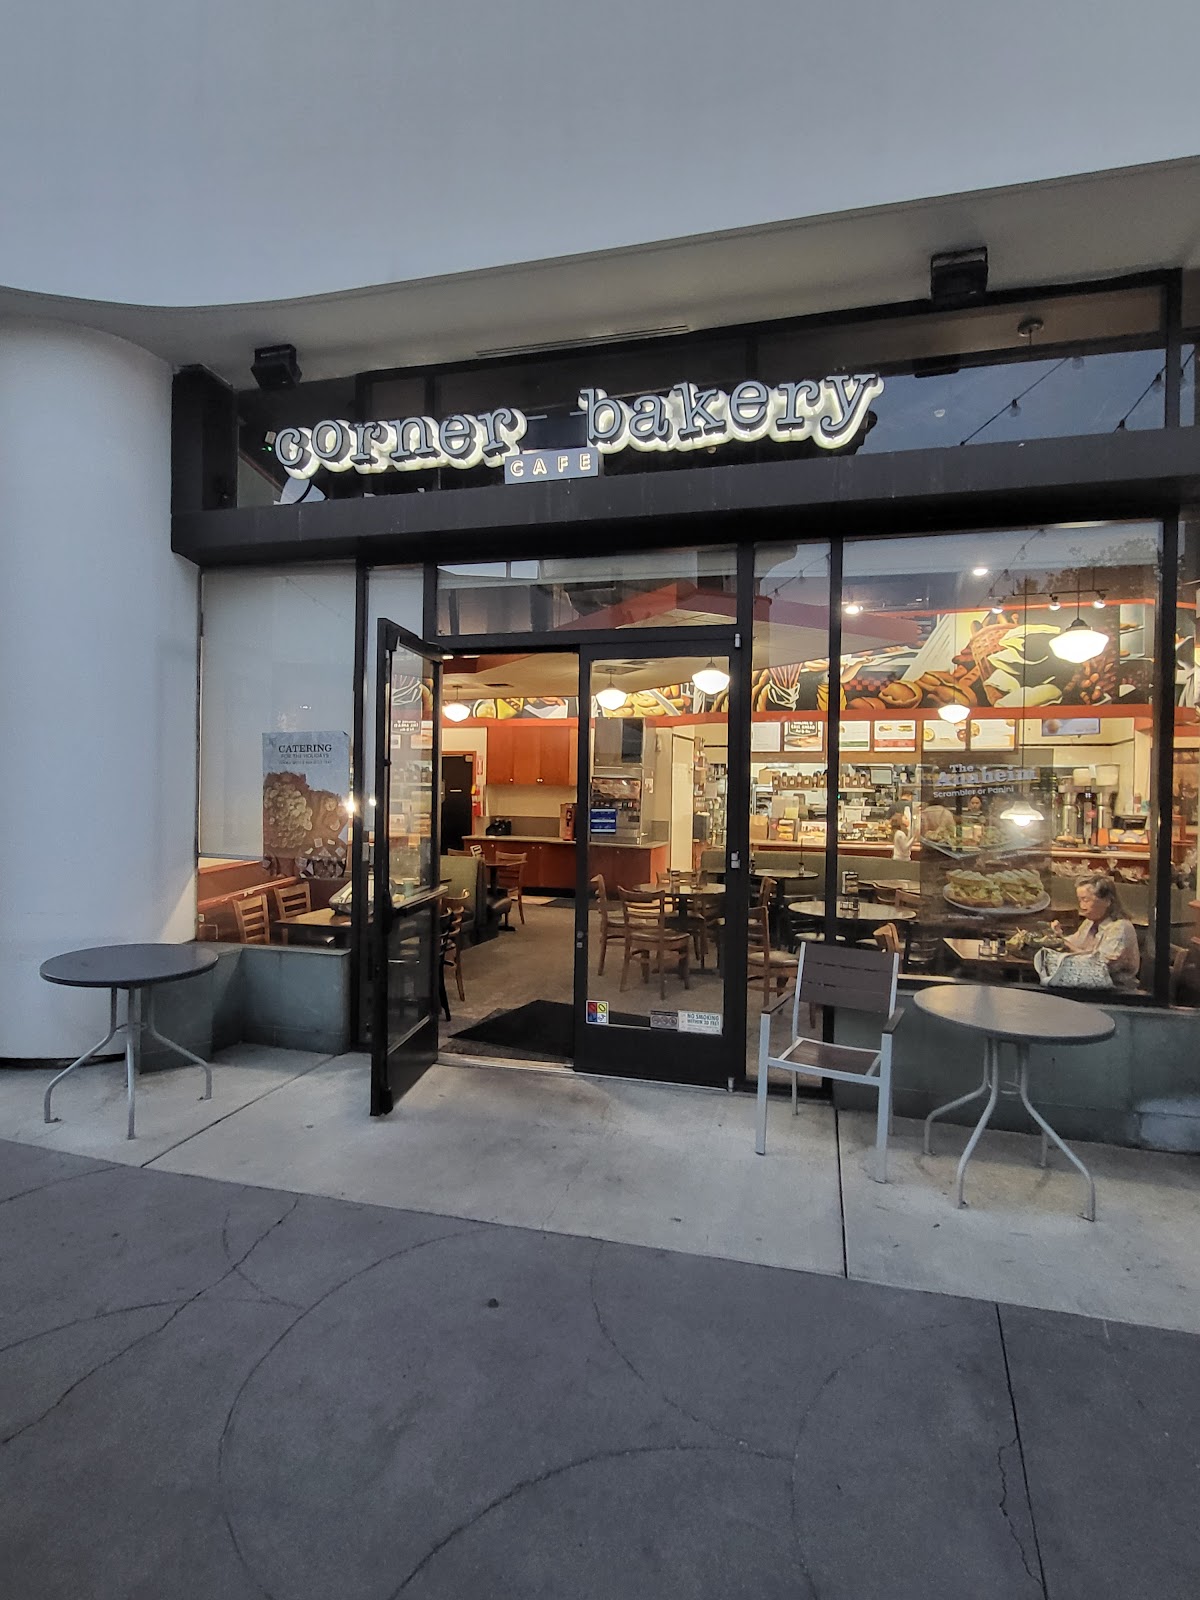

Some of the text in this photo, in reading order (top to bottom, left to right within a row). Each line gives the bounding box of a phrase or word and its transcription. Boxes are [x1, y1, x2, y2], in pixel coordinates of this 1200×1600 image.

[275, 373, 881, 472] corner bakery
[510, 453, 591, 477] CAFE
[278, 744, 332, 753] CATERING
[949, 764, 974, 773] The
[936, 766, 1037, 786] Anaheim
[987, 786, 1014, 794] Panini
